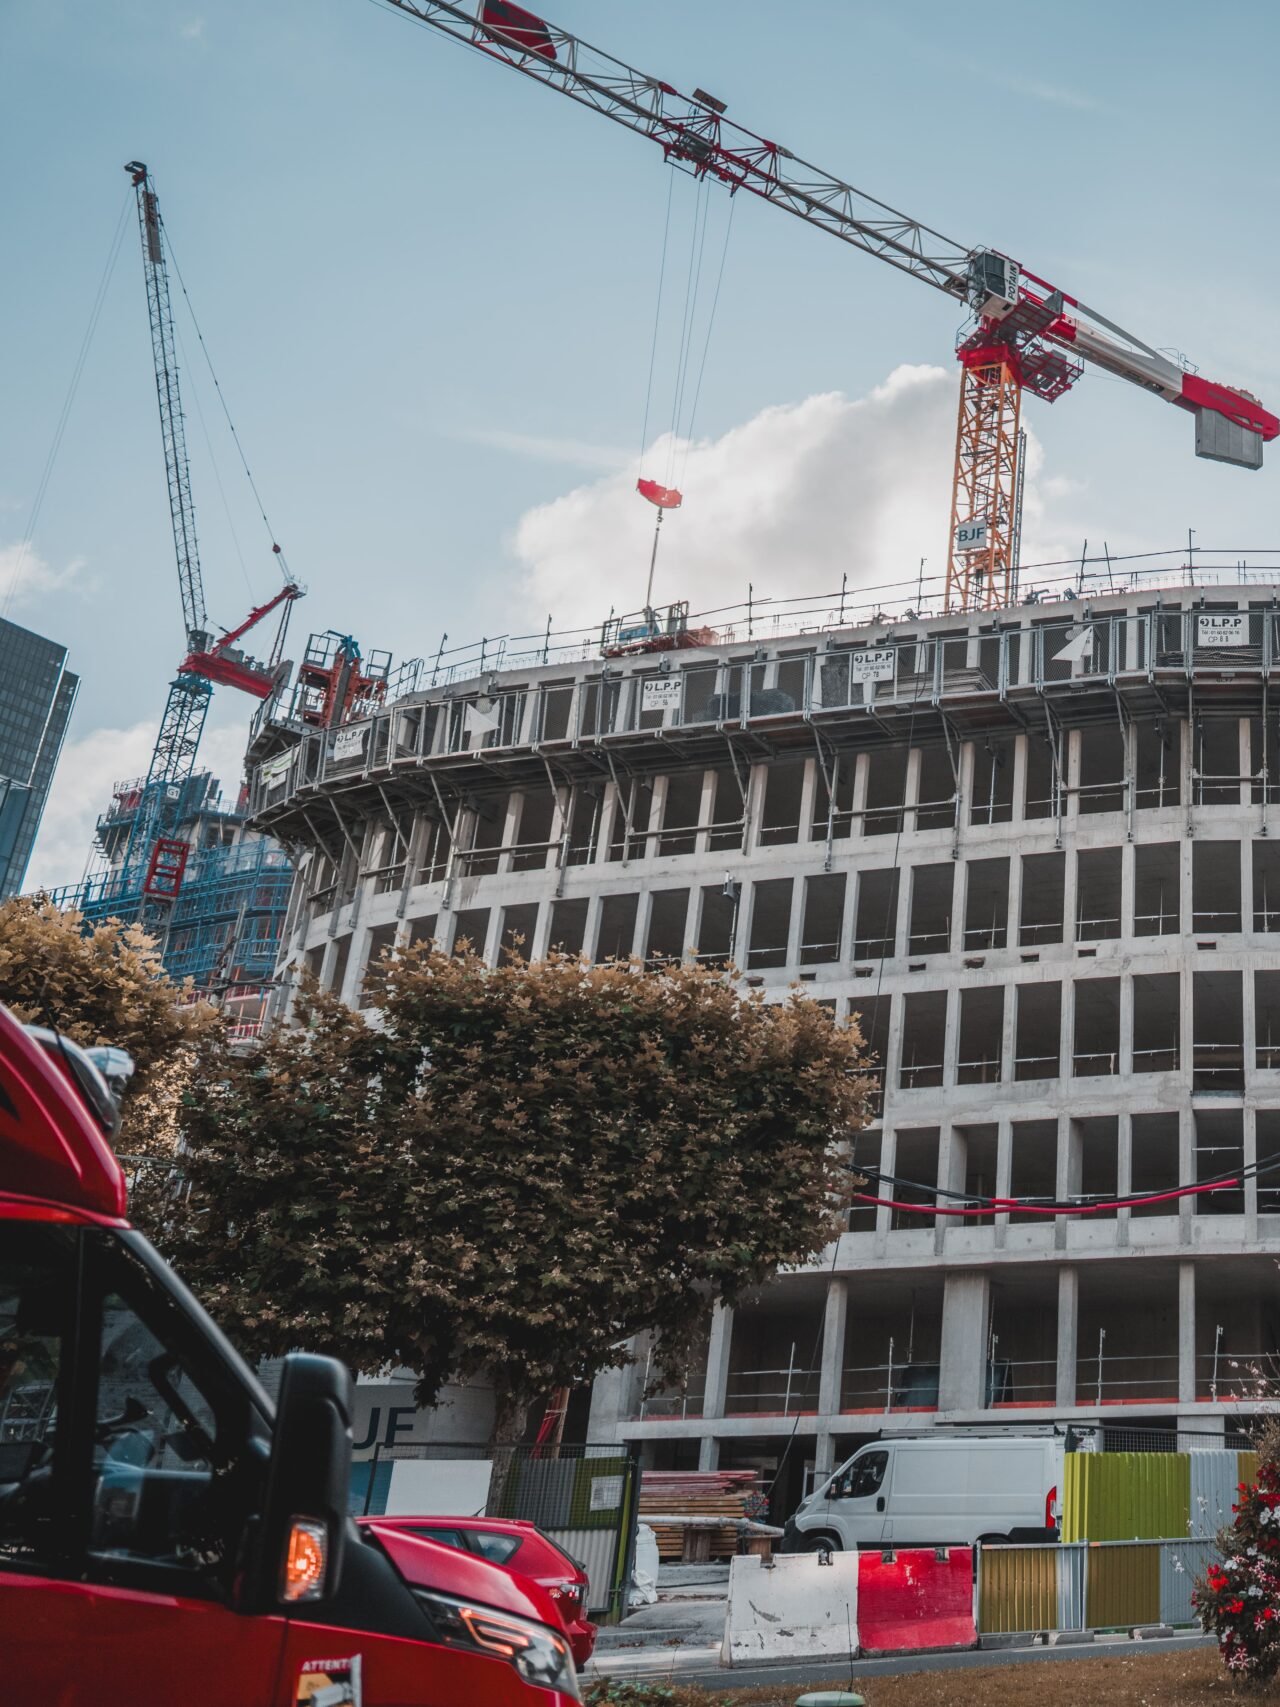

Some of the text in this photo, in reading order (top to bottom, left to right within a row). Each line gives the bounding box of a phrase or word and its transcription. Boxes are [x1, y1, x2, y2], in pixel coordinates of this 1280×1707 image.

[1008, 264, 1017, 301] POTAIN
[958, 527, 985, 542] BJF
[1211, 618, 1242, 628] L.P.P
[865, 652, 893, 663] L.P.P
[655, 681, 681, 691] L.P.P
[352, 1406, 417, 1450] JF
